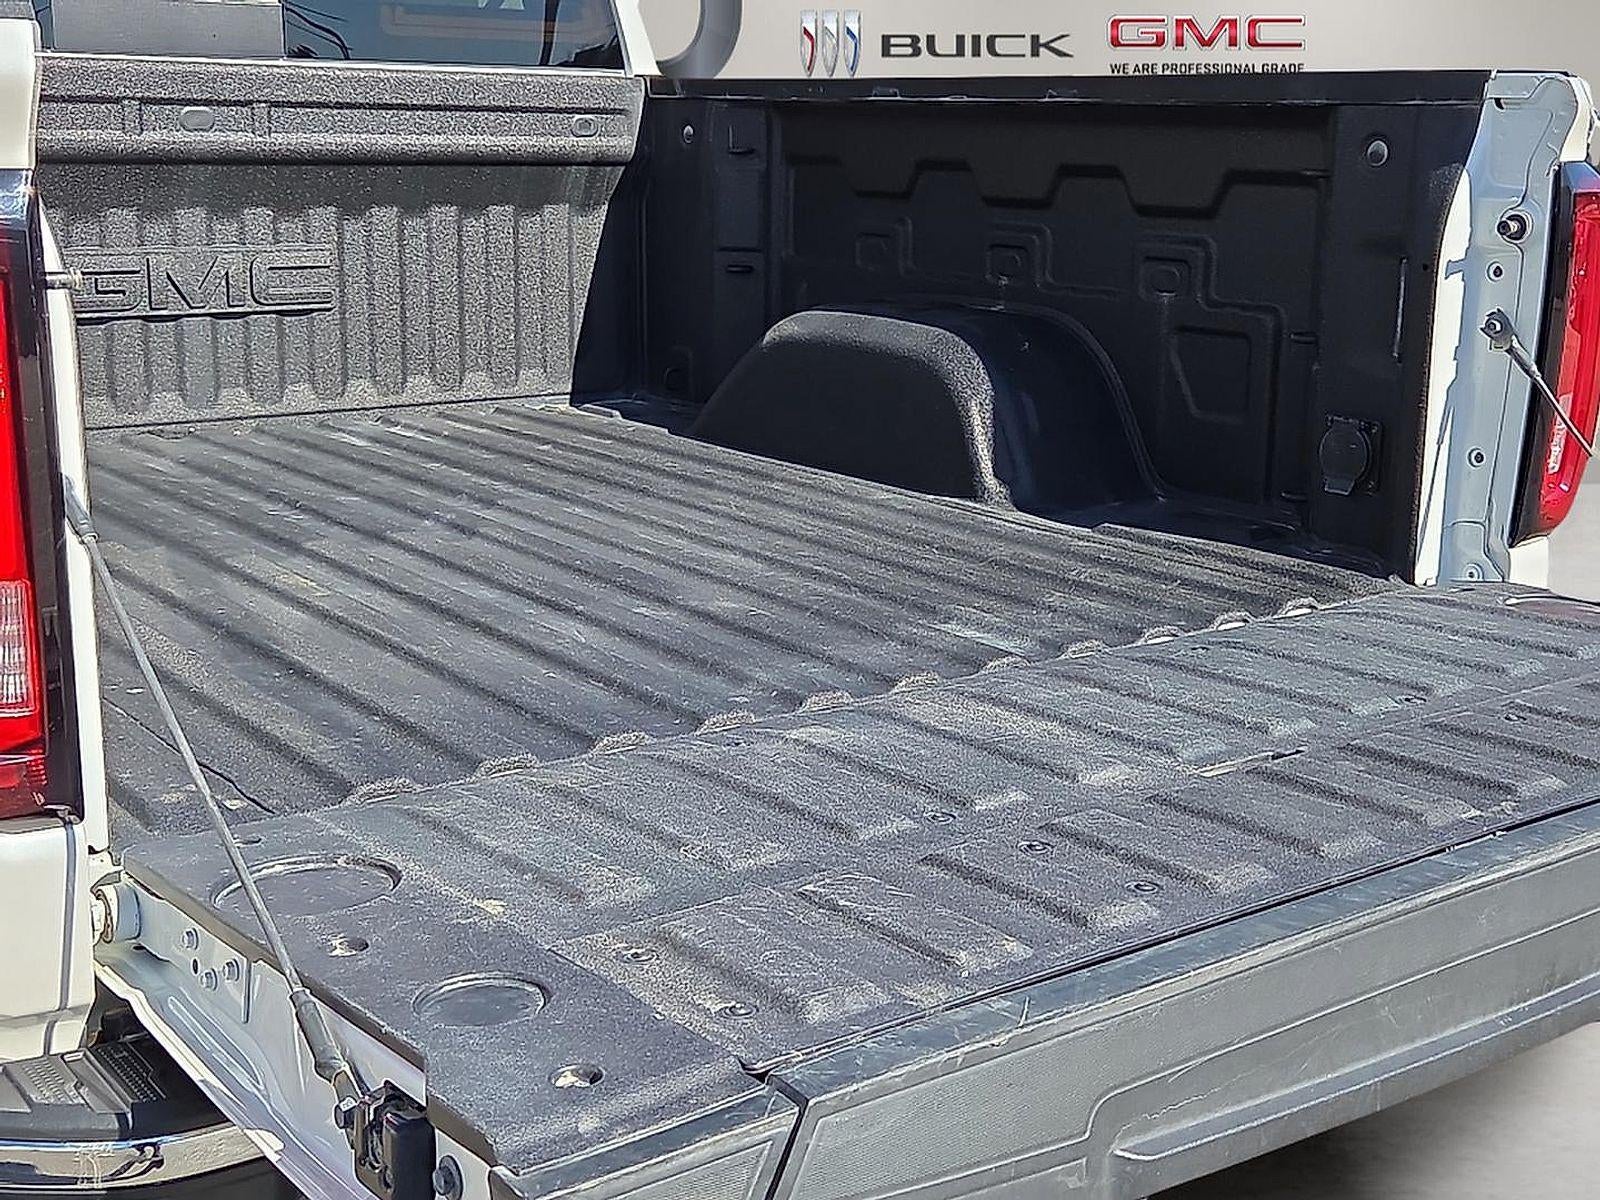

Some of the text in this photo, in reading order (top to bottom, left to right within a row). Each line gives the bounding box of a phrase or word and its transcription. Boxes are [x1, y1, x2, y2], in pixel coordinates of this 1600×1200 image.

[881, 34, 1074, 58] BUICK
[1107, 14, 1306, 50] GMC
[1110, 63, 1305, 75] WE ARE PROFESSIONAL GRADE
[68, 250, 335, 313] GMC
